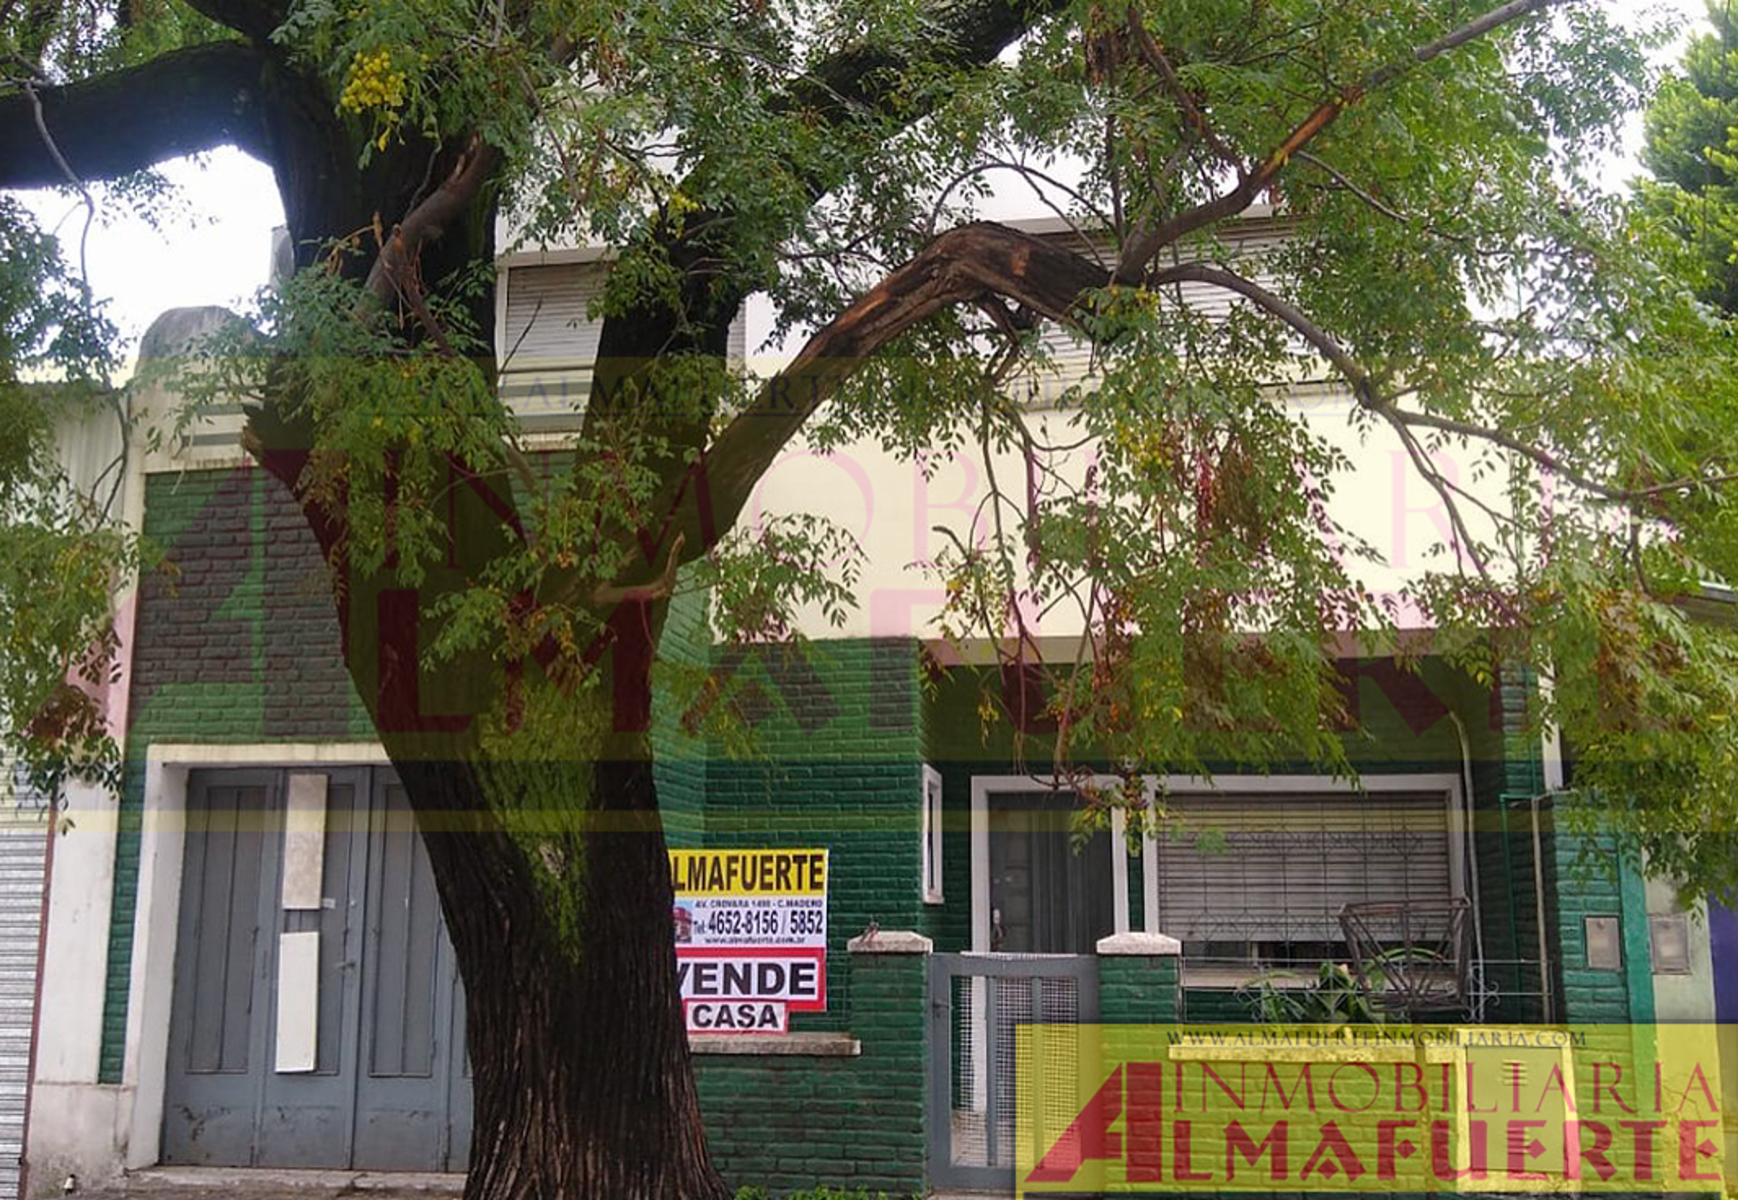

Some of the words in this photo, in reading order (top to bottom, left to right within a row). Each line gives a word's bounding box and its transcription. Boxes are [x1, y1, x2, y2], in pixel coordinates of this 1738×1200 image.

[673, 855, 824, 891] LMAFUERTE
[709, 910, 778, 935] 4652-8156
[790, 910, 823, 935] 5852
[692, 1004, 779, 1028] CASA
